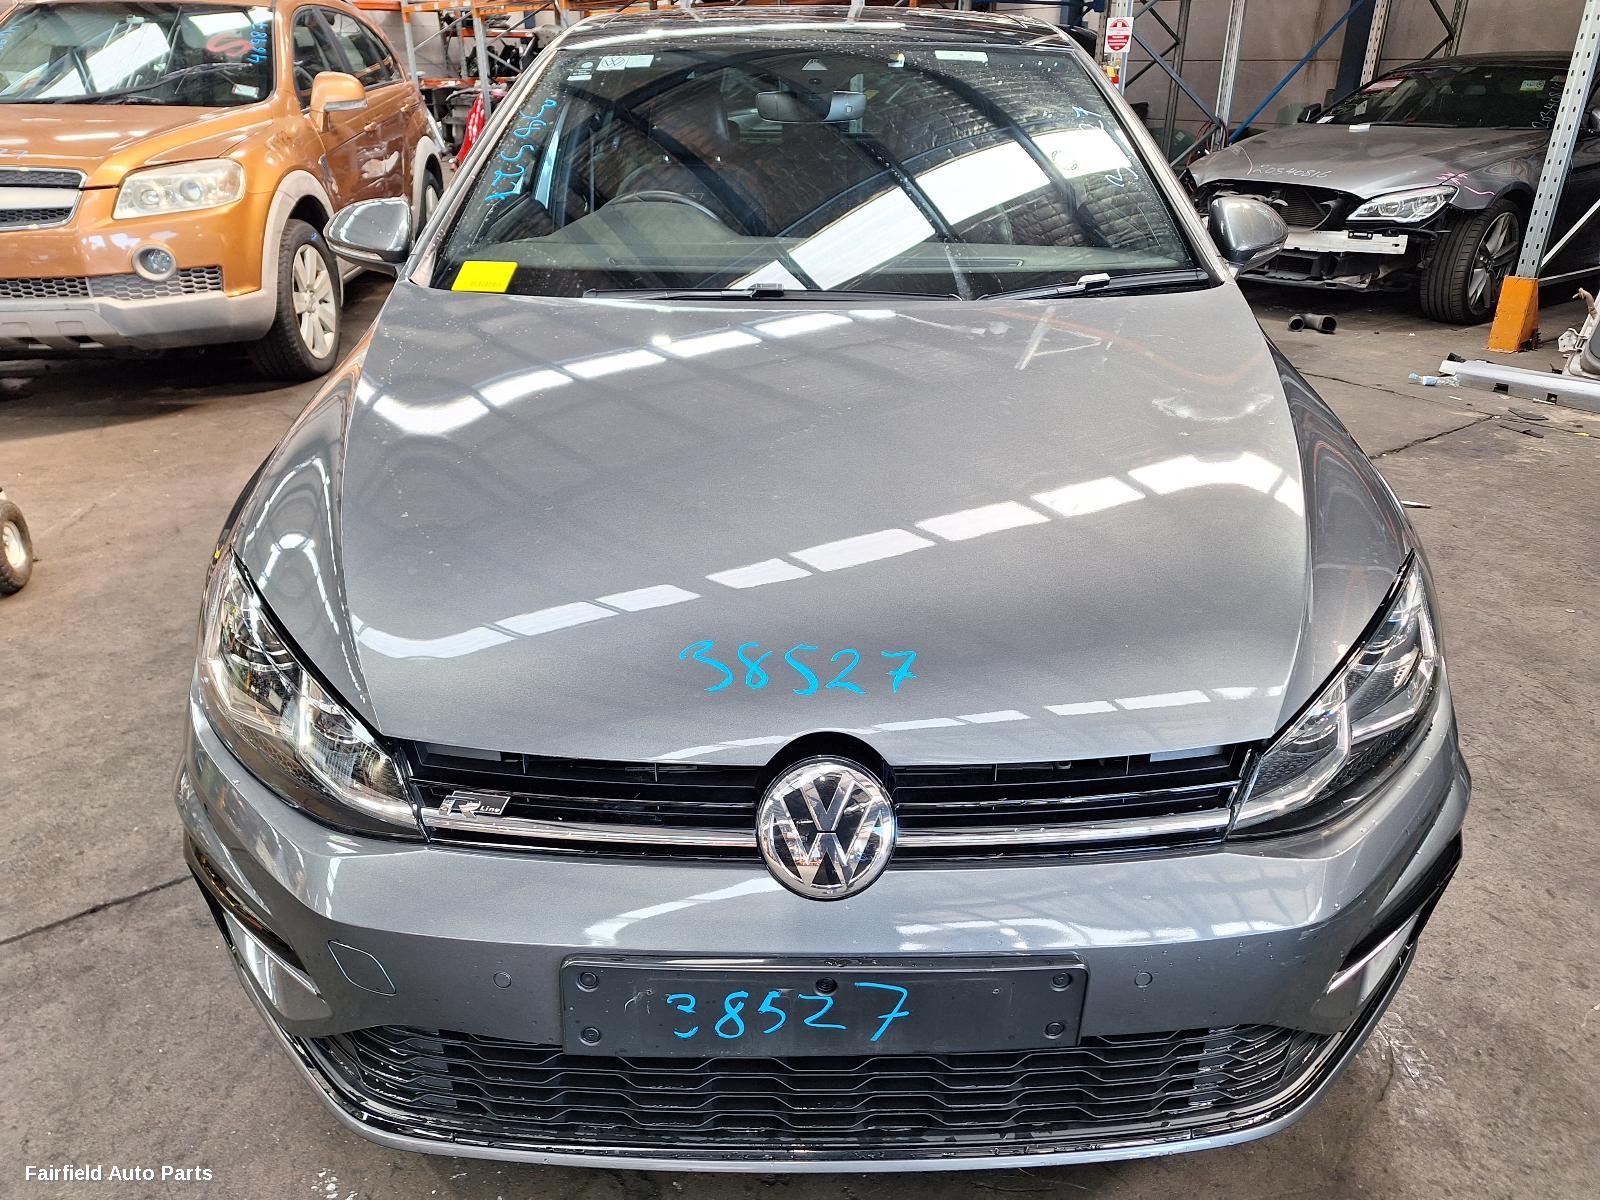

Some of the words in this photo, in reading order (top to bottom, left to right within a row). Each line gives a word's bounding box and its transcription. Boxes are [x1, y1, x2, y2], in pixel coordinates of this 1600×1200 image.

[679, 639, 919, 695] 38527
[479, 805, 501, 813] Line
[665, 981, 911, 1042] 38527
